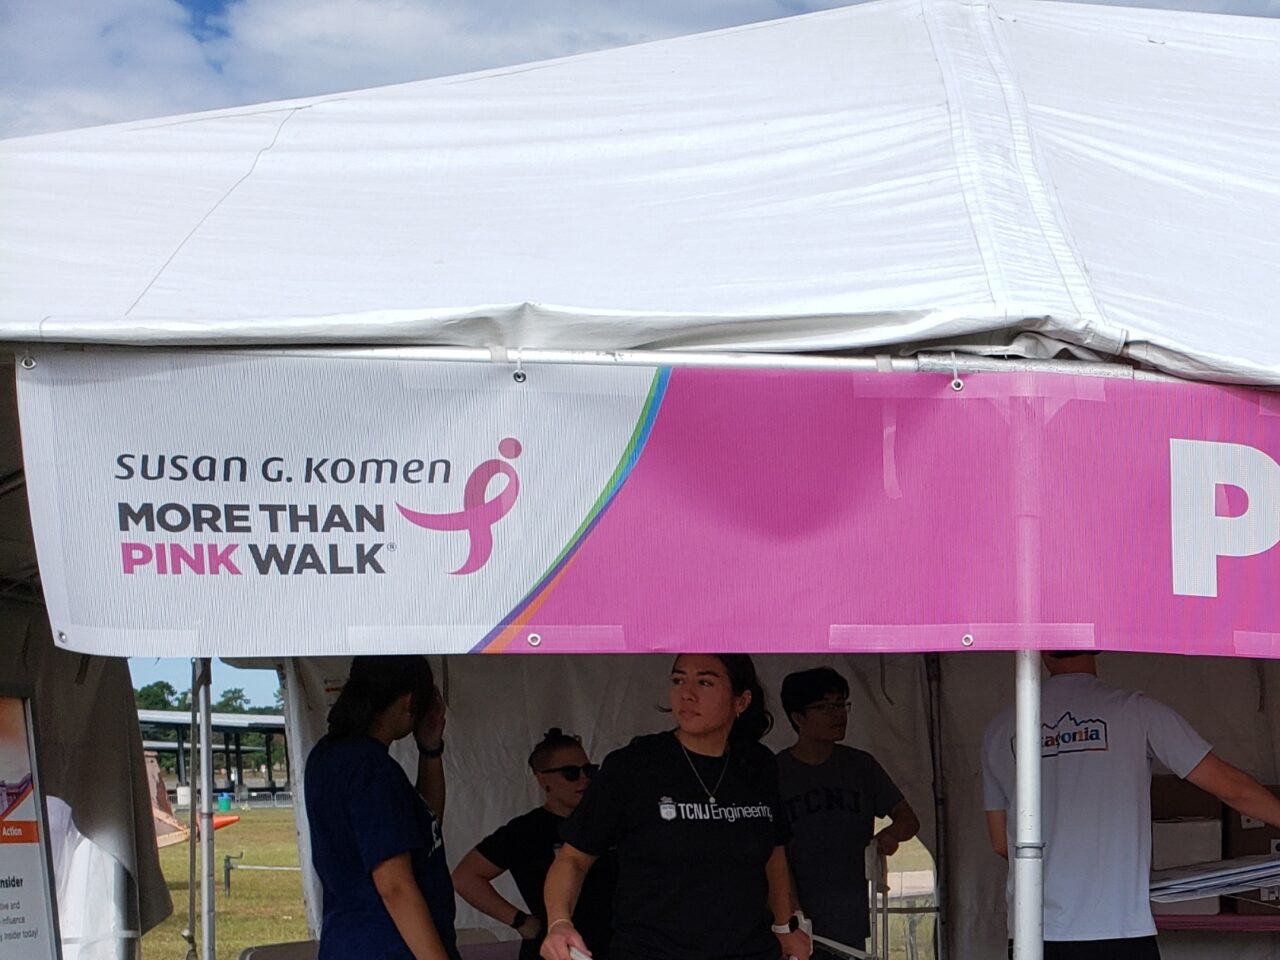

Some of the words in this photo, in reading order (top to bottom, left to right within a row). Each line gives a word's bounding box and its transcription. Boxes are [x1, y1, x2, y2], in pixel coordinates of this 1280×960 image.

[261, 457, 293, 482] G.
[118, 502, 251, 533] MORE
[259, 503, 386, 533] THAN
[121, 542, 243, 576] PINK
[678, 803, 710, 820] TCNJ
[0, 876, 23, 888] nsider
